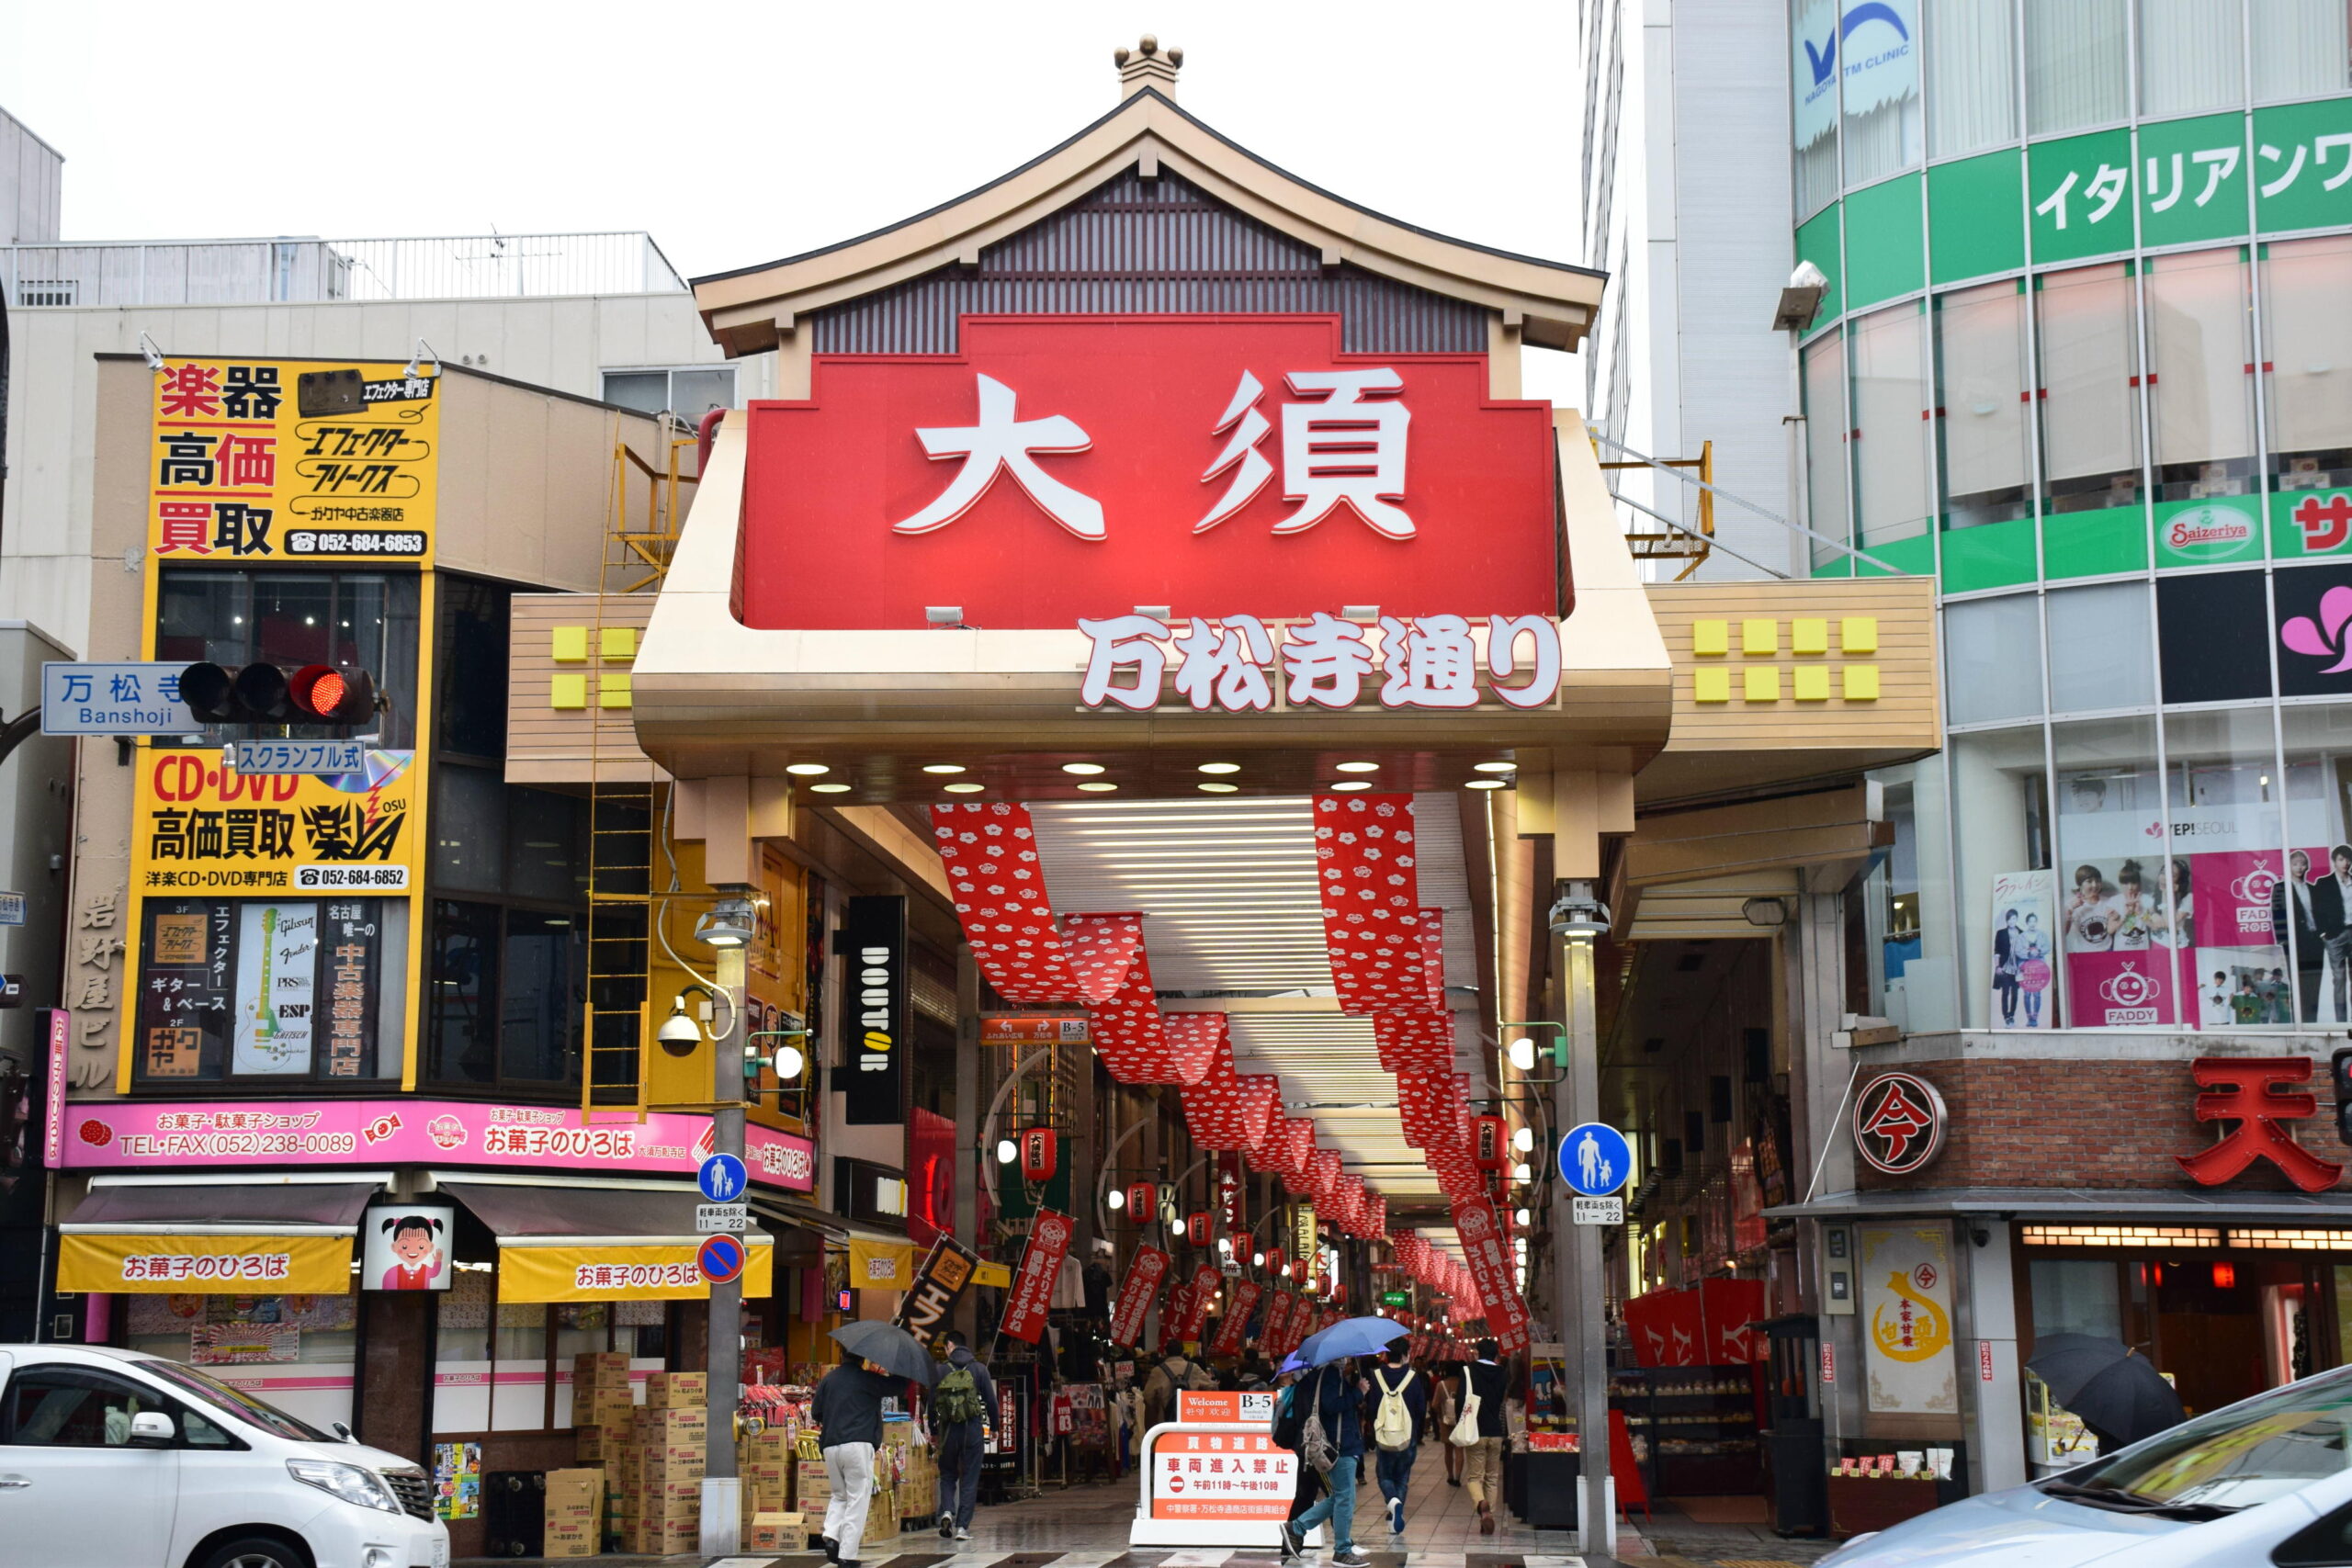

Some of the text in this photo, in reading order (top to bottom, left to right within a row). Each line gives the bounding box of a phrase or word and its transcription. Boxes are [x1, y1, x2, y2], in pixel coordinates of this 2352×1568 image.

[1865, 44, 1909, 70] CLINIC
[161, 363, 282, 420] 楽器
[363, 377, 430, 401] エフェクター専門店
[303, 427, 411, 457] エフェクター
[159, 432, 277, 487] 高価
[891, 367, 1418, 542] 大須
[310, 464, 399, 493] フリークス
[310, 507, 404, 522] ガクヤ中古楽器店
[2295, 495, 2352, 550] サ
[154, 502, 275, 557] 買取
[2170, 523, 2247, 548] Saizeriya
[319, 534, 423, 552] 052-684-6853
[1077, 612, 1562, 712] 万松寺通り
[61, 673, 184, 704] 万松寺
[79, 708, 173, 727] Banshoji
[241, 746, 359, 768] スクランブル式
[382, 799, 407, 814] OSU
[151, 807, 295, 861] 高価買取
[145, 871, 288, 887] 洋楽CD・DVD専門店
[322, 869, 404, 886] 052-684-6852
[175, 906, 189, 914] 3F
[329, 905, 361, 919] 名古屋
[2240, 909, 2272, 920] FAD
[280, 917, 314, 938] Gibson
[343, 922, 375, 938] 唯一の
[213, 906, 230, 987] エフェクター
[279, 943, 313, 964] Fender
[74, 894, 117, 1089] 岩野屋ビル
[152, 977, 201, 993] ギター
[277, 976, 299, 987] PRS
[163, 996, 226, 1011] & ベース
[279, 1004, 311, 1019] ESP
[329, 942, 366, 1077] 中古楽器専門店
[860, 946, 892, 1072] DOUTOR
[170, 1019, 184, 1027] 2F
[2108, 1010, 2154, 1021] FADDY
[1063, 1021, 1085, 1032] B-5
[157, 1111, 321, 1130] お菓子・駄菓子ショップ
[1861, 1080, 1932, 1164] 今
[2174, 1056, 2344, 1192] 天
[485, 1128, 634, 1159] お菓子のひろば
[699, 1207, 744, 1217] 軽車両を除く
[1576, 1200, 1621, 1211] 軽車両を除く
[122, 1254, 290, 1280] お菓子のひろば
[575, 1262, 701, 1291] お菓子のひろば
[1031, 1255, 1060, 1315] どえりゃあ
[1898, 1298, 1913, 1348] 本家甘栗
[442, 1372, 483, 1382] お菓子のひろば
[1188, 1397, 1228, 1406] Welcome
[1241, 1394, 1272, 1408] B-5
[1059, 1415, 1072, 1431] 03
[1187, 1436, 1269, 1450] 買物道路
[1167, 1457, 1289, 1474] 車両進入禁止
